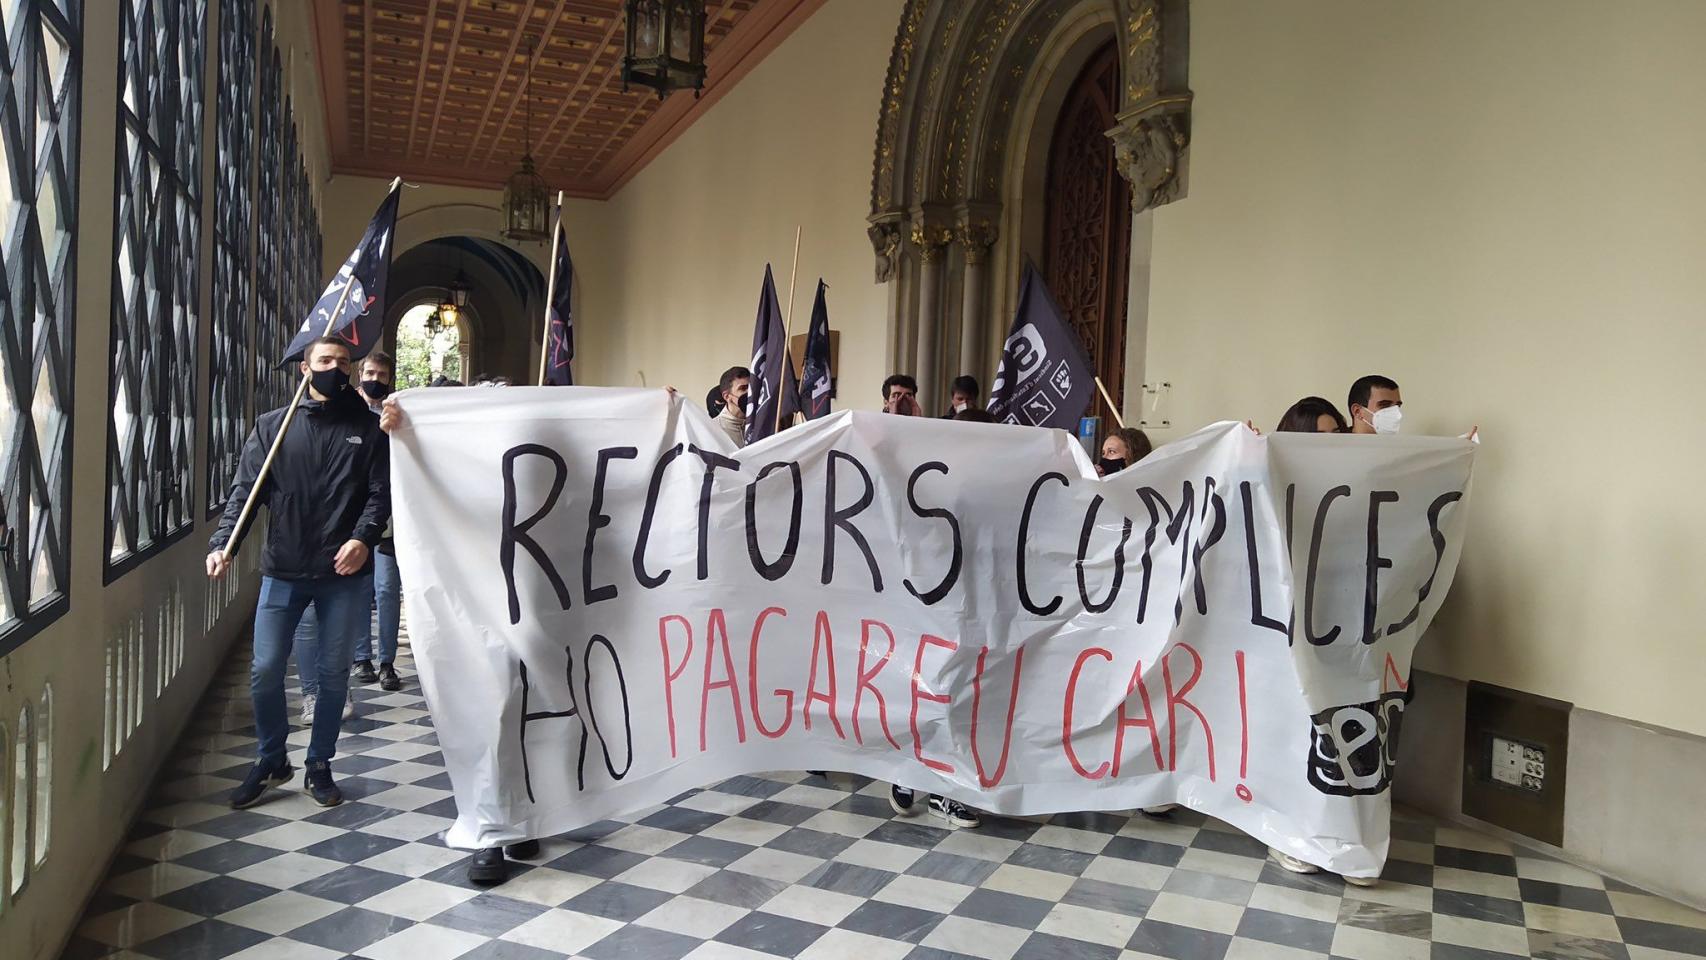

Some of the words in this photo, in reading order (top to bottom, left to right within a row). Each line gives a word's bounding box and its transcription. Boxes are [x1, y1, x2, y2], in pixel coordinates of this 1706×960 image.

[500, 443, 962, 625] RECTORS
[518, 634, 632, 804] HO
[658, 606, 1025, 789] PAGAREU
[1063, 642, 1253, 803] CAR!
